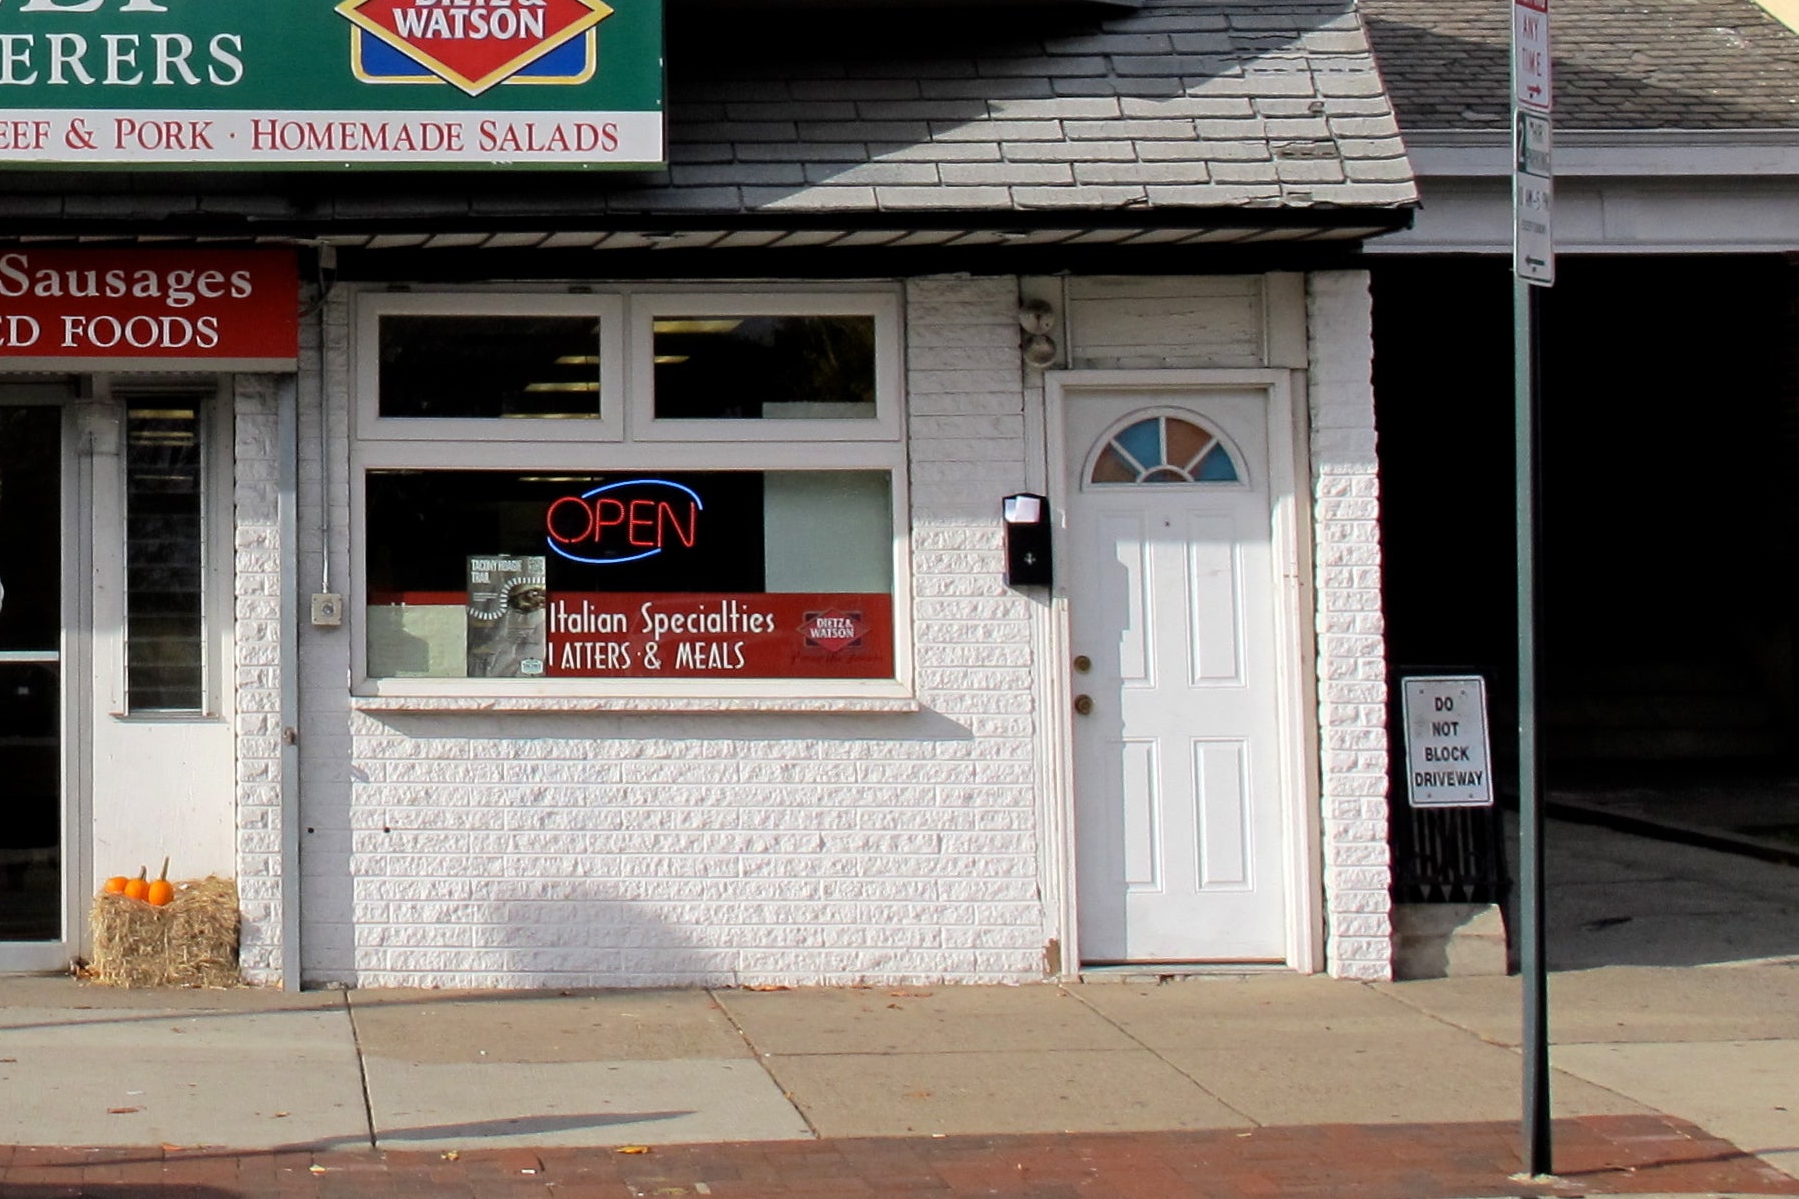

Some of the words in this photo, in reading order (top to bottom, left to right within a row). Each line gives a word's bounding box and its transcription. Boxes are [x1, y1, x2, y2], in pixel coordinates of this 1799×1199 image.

[393, 7, 545, 40] WATSON
[1523, 14, 1539, 41] ANY
[1522, 47, 1542, 78] TIME
[64, 118, 95, 151] &
[114, 118, 214, 151] PORK
[251, 118, 464, 152] HOMEMADE
[479, 118, 619, 152] SALADS
[60, 314, 220, 350] FOODS
[547, 496, 696, 547] OPEN
[551, 600, 627, 633] Italian
[641, 600, 775, 641] Specialties
[810, 628, 855, 639] WATSON
[816, 618, 844, 629] DIETZ
[643, 641, 662, 670] &
[675, 641, 745, 670] MEALS
[1434, 696, 1454, 712] DO
[1432, 721, 1459, 737] NOT
[1425, 746, 1470, 762] BLOCK
[1414, 771, 1483, 787] DRIVEWAY
